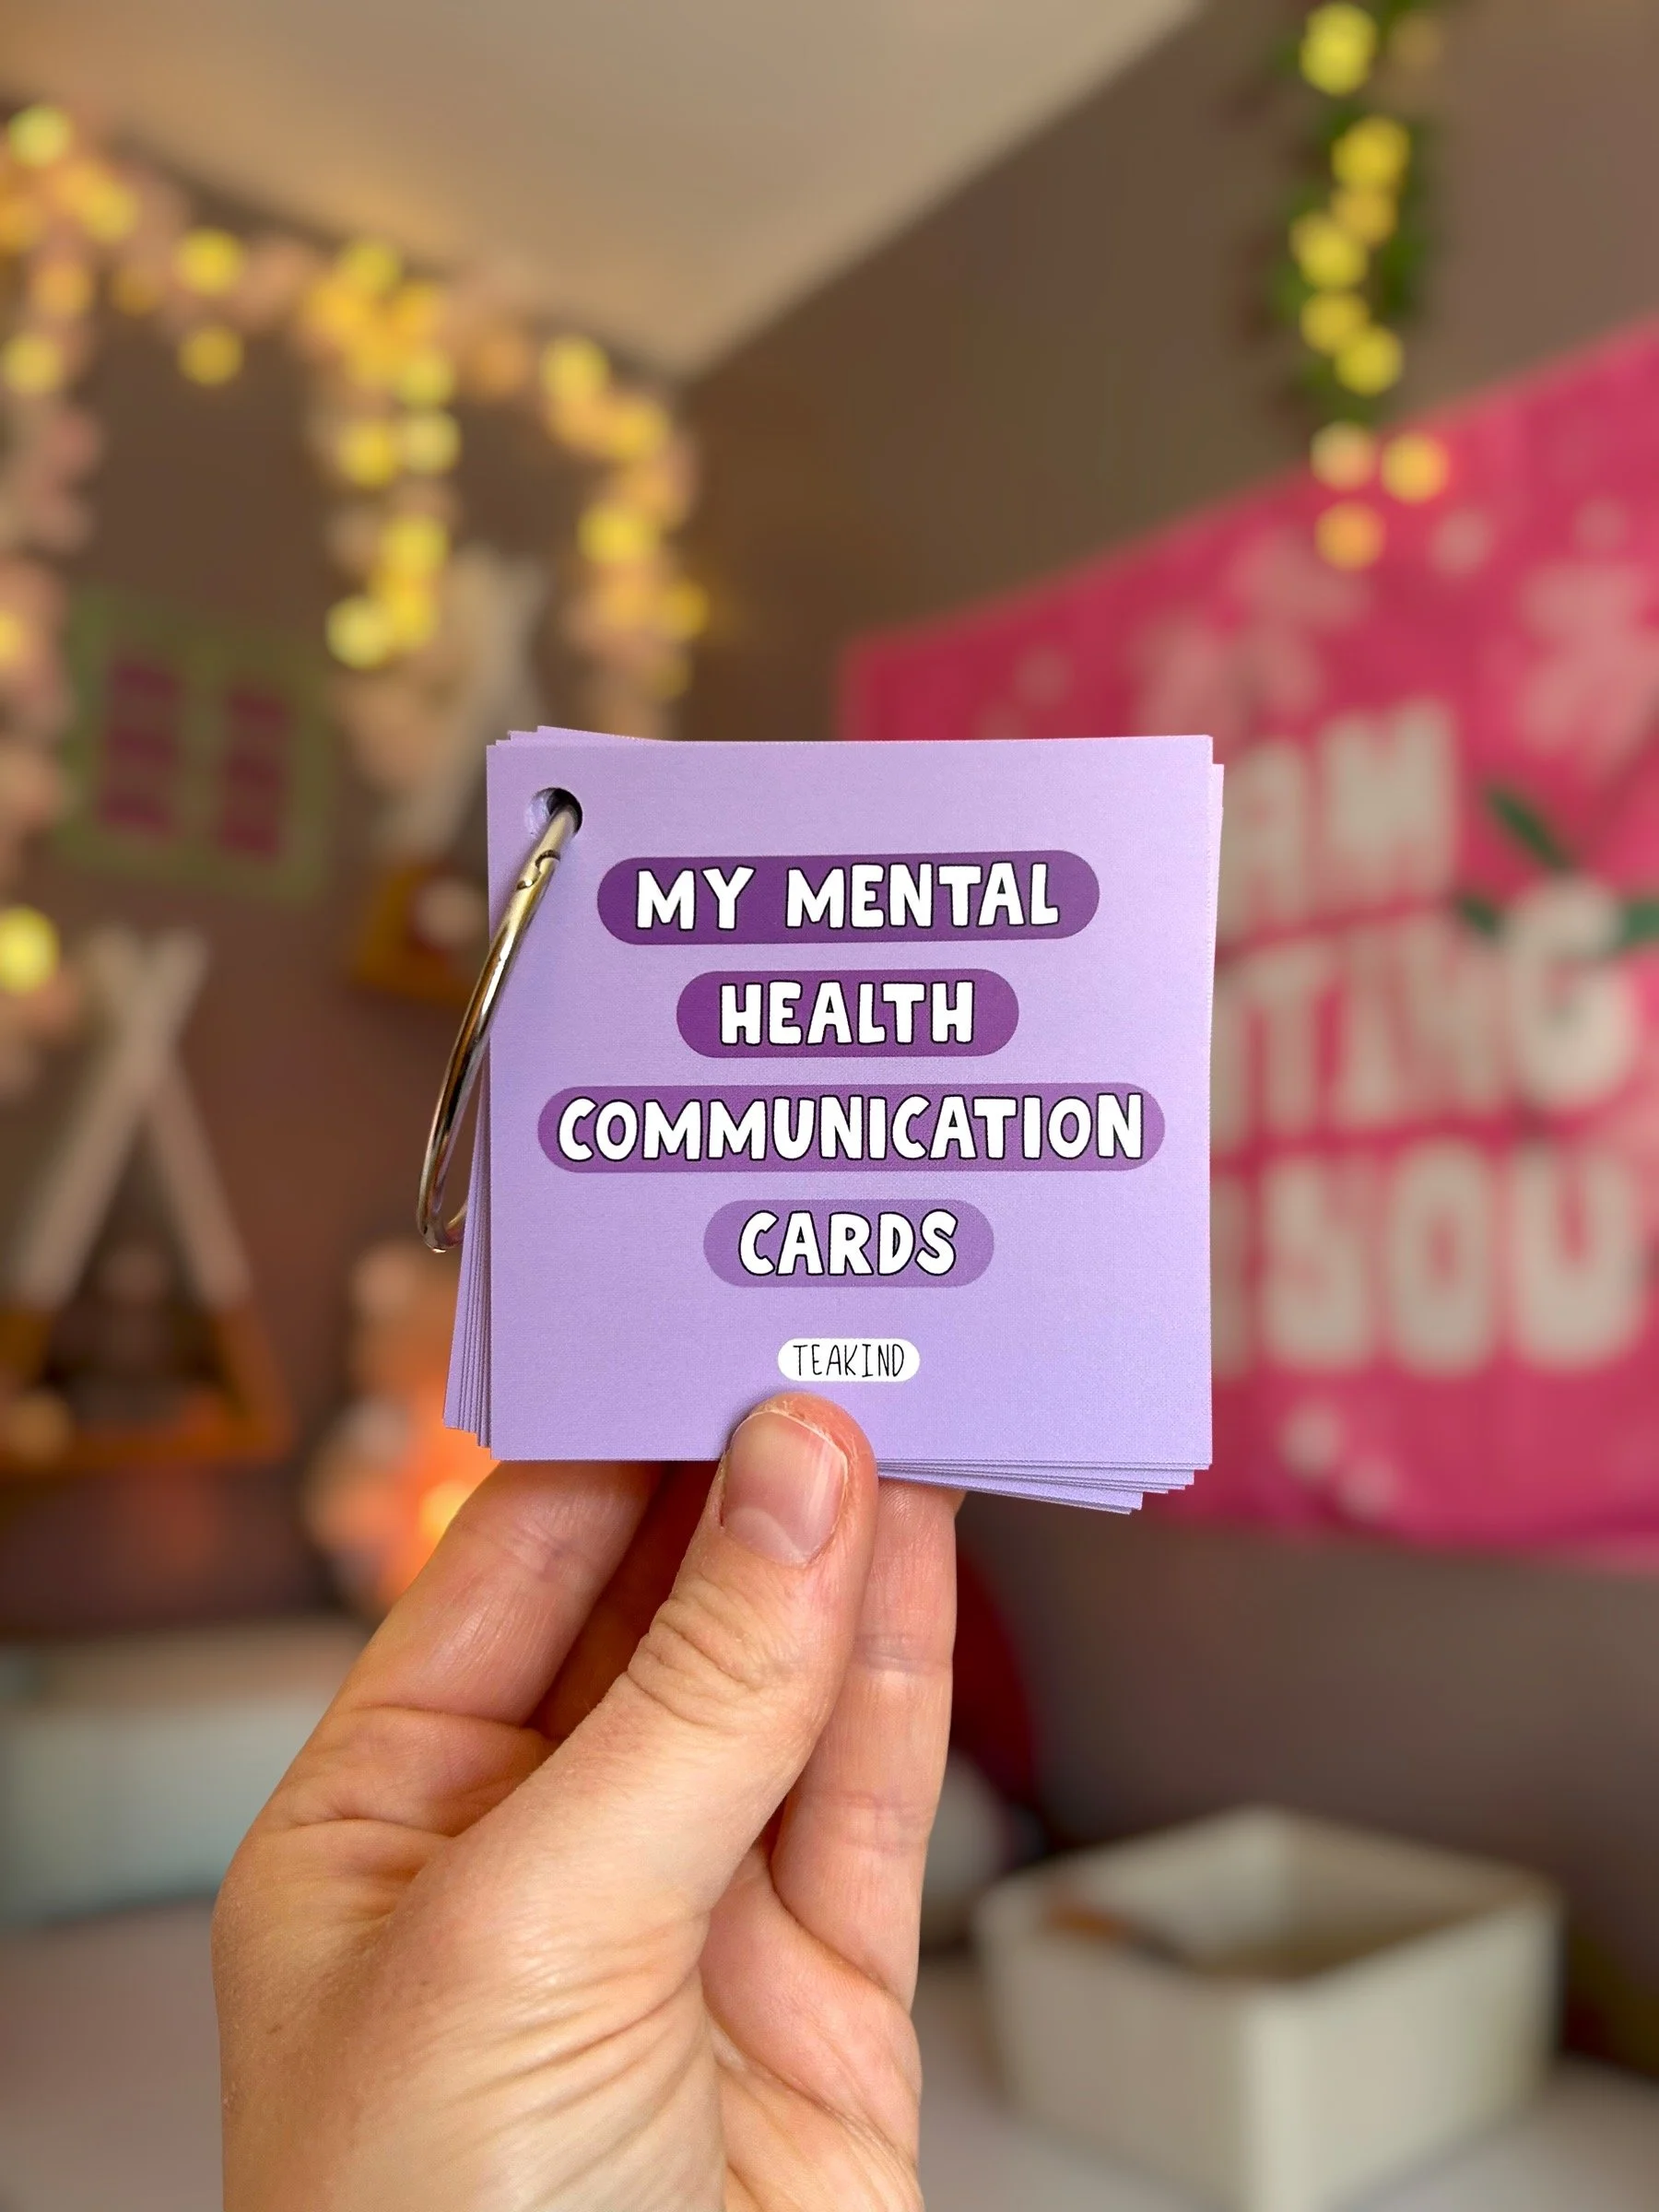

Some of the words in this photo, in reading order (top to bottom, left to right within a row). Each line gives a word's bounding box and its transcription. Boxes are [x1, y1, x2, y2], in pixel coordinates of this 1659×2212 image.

[635, 865, 756, 931] MY
[784, 862, 1060, 930] MENTAL
[719, 980, 976, 1046] HEALTH
[557, 1092, 1145, 1162] COMMUNICATION
[738, 1208, 959, 1277] CARDS
[792, 1343, 906, 1379] TEAKIND
